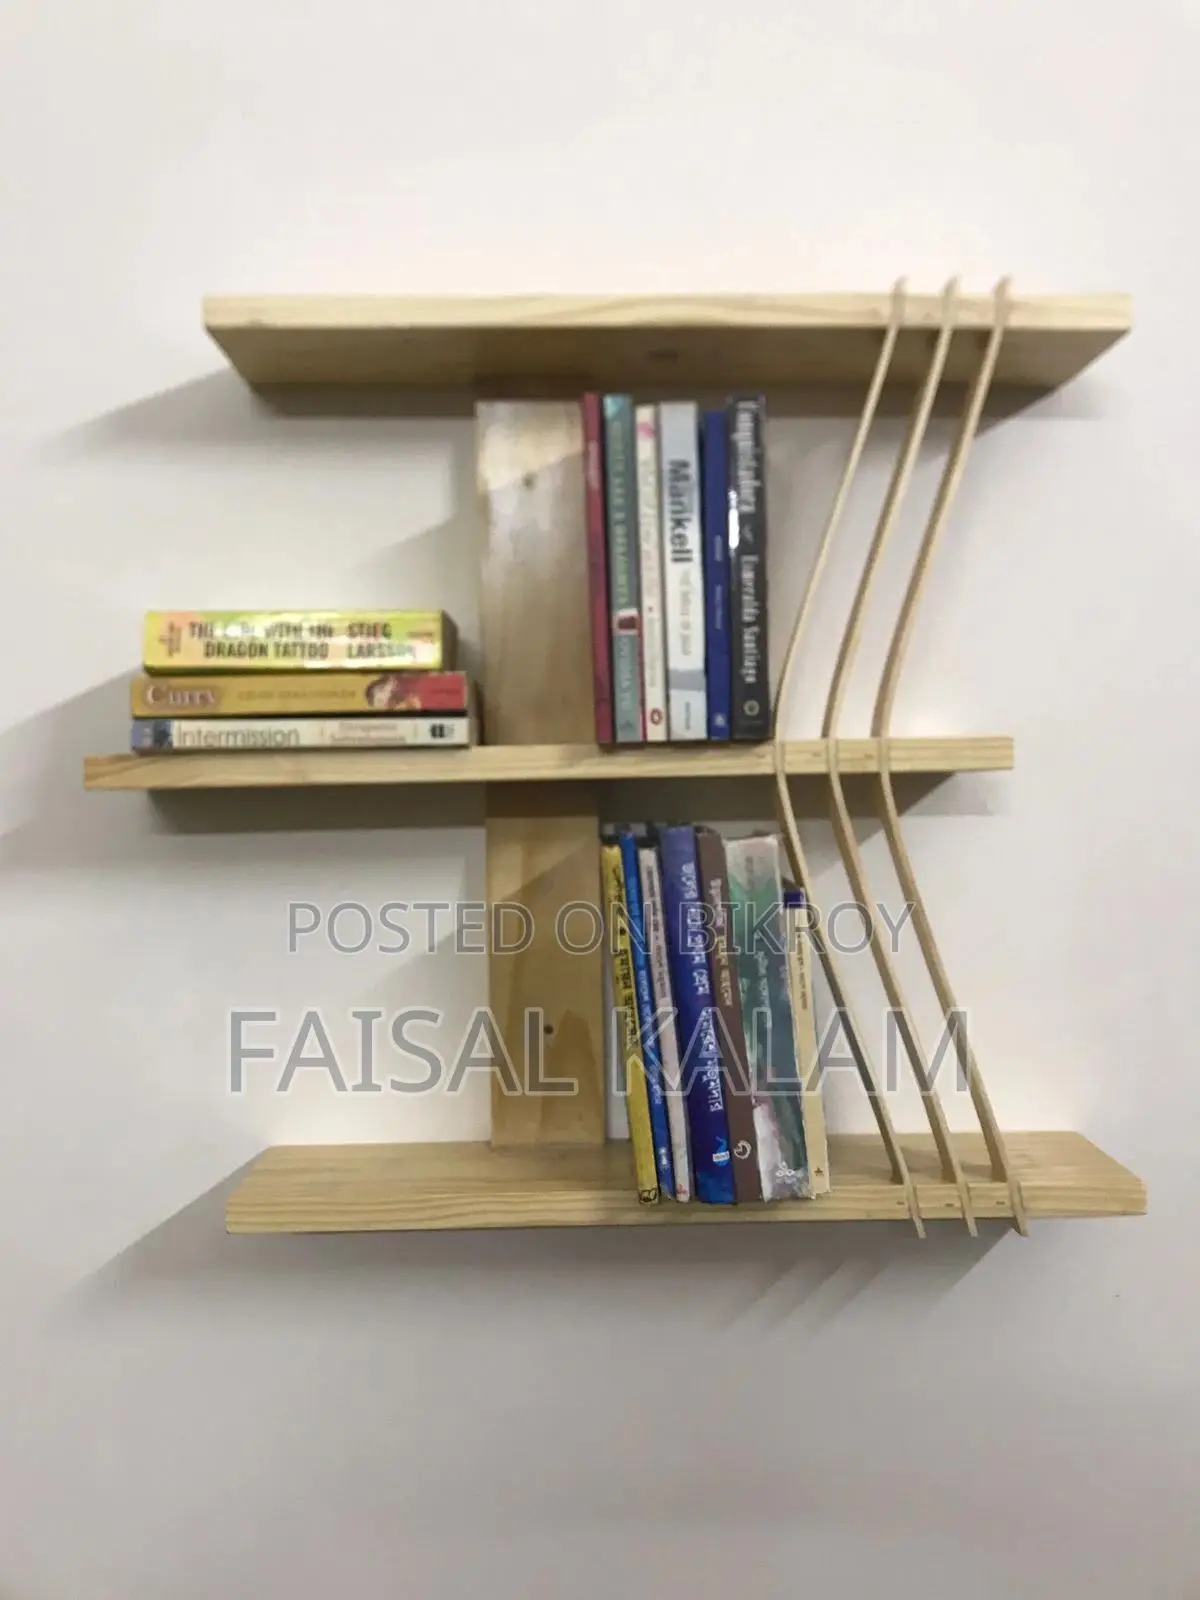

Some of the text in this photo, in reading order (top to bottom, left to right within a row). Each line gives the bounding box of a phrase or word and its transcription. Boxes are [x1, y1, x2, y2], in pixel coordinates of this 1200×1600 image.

[668, 459, 693, 562] Mankell
[204, 641, 329, 659] DRAGON TATTOO
[147, 683, 216, 705] Curry
[177, 721, 301, 748] Intermission
